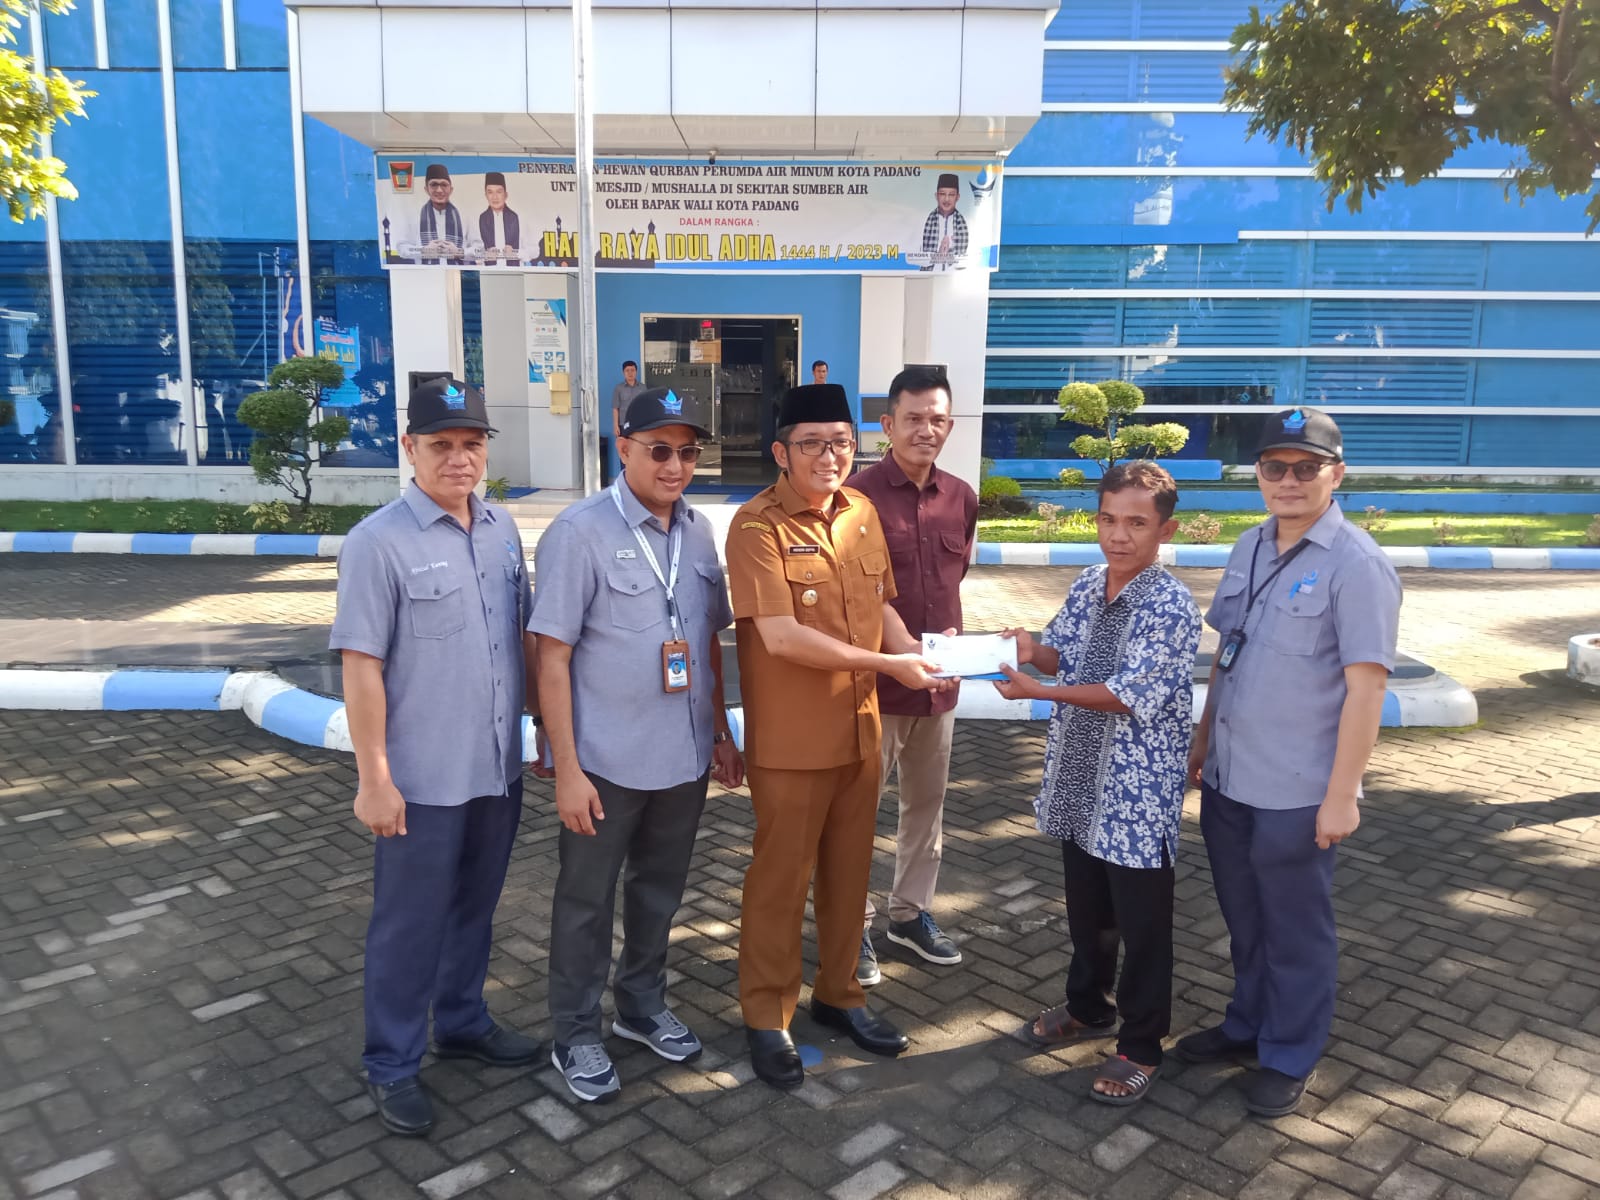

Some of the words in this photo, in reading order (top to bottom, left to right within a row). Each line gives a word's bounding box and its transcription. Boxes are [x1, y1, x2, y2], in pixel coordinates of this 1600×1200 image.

[519, 163, 599, 175] PENYERAN
[603, 165, 645, 175] HEWAN
[650, 165, 699, 176] QURBAN
[703, 166, 763, 176] PERUMDA
[766, 167, 787, 176] AIR
[790, 167, 833, 176] MINUM
[838, 167, 870, 176] KOTA
[874, 167, 921, 177] PADANG
[551, 181, 578, 192] UNT
[596, 182, 642, 193] MESJID
[644, 183, 649, 194] /
[652, 183, 717, 194] MUSHALLA
[720, 184, 733, 194] DI
[736, 184, 789, 194] SEKITAR
[793, 184, 844, 194] SUMBER
[847, 184, 868, 194] AIR
[606, 199, 638, 210] OLEH
[642, 200, 680, 210] BAPAK
[684, 200, 712, 210] WALI
[716, 201, 749, 210] KOTA
[752, 201, 799, 211] PADANG
[680, 217, 711, 226] DALAM
[715, 218, 753, 227] RANGKA
[543, 231, 578, 258] HA
[600, 232, 660, 260] RAYA
[665, 233, 712, 260] IDUL
[719, 234, 776, 261] ADHA
[780, 245, 815, 259] 1444
[820, 245, 830, 259] H
[834, 244, 842, 263] /
[847, 245, 882, 260] 2023
[887, 245, 899, 260] M
